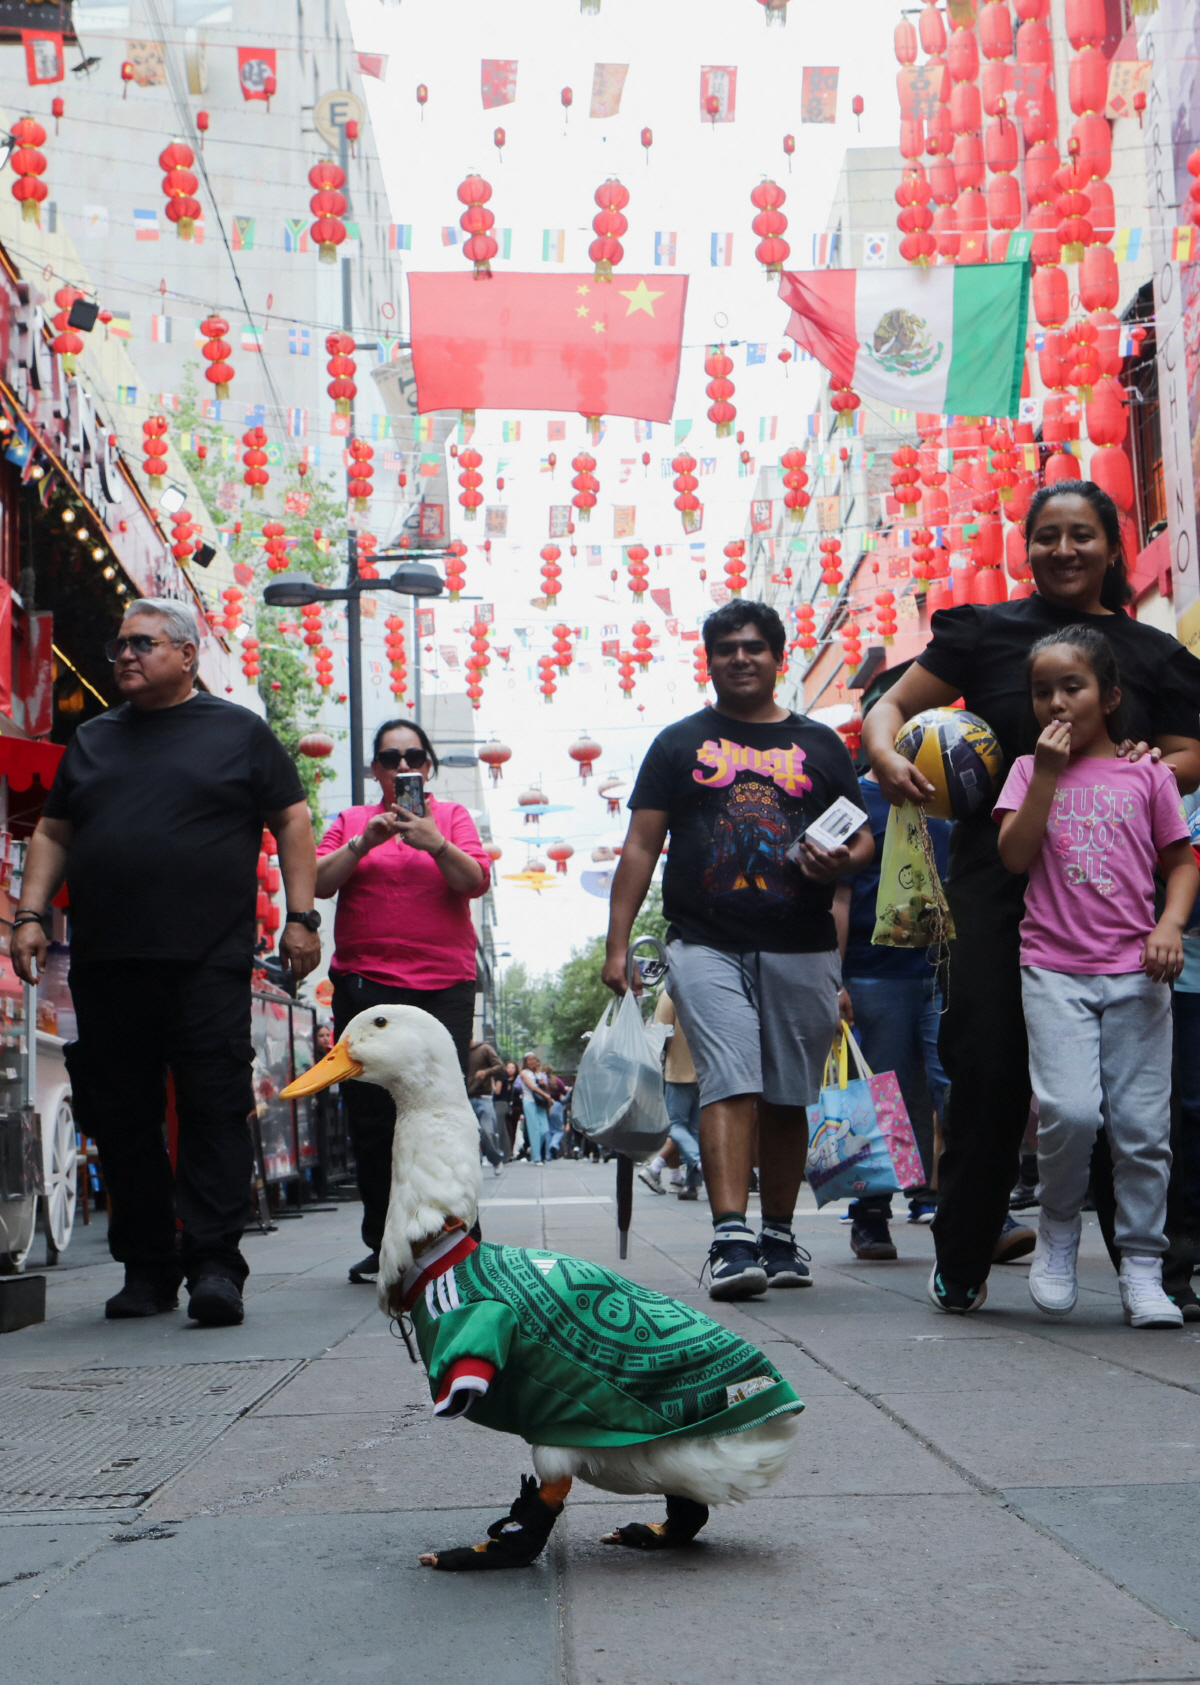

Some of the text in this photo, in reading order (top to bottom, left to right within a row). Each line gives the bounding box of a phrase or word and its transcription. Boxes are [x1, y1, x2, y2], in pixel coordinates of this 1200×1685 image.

[1165, 333, 1190, 573] CHINO
[1056, 787, 1129, 822] JUST
[1069, 818, 1115, 852] DO
